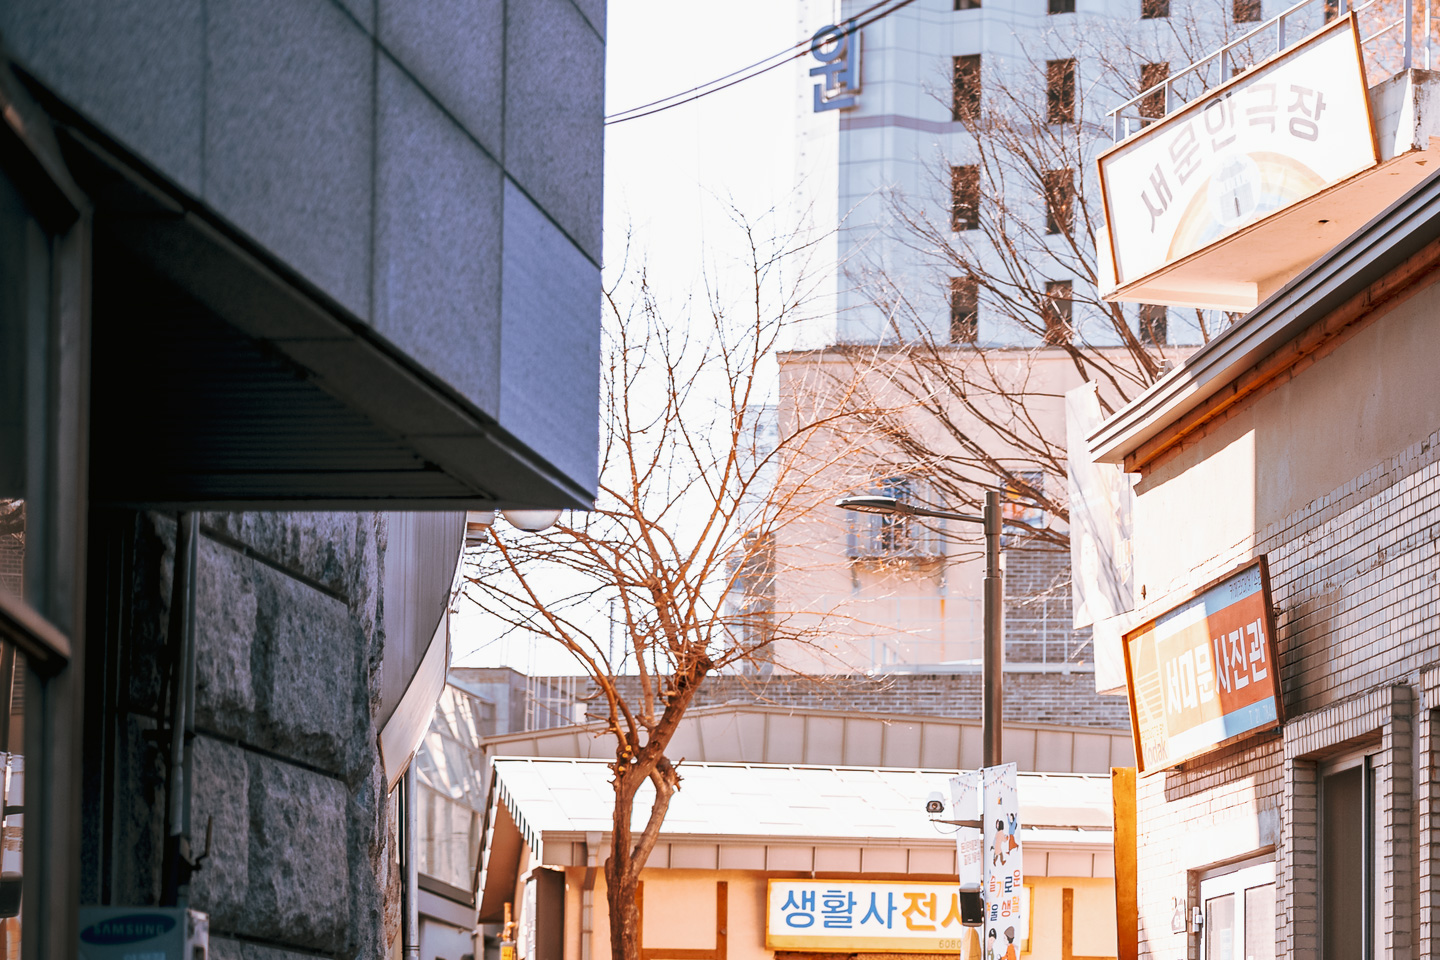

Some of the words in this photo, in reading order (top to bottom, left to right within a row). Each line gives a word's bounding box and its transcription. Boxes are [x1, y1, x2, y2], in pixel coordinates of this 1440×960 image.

[809, 19, 856, 113] 원
[1140, 82, 1327, 234] 새문안극장
[1165, 617, 1268, 716] 서대문사진관
[1142, 736, 1169, 766] Kodak
[93, 923, 165, 937] SAMSUNG
